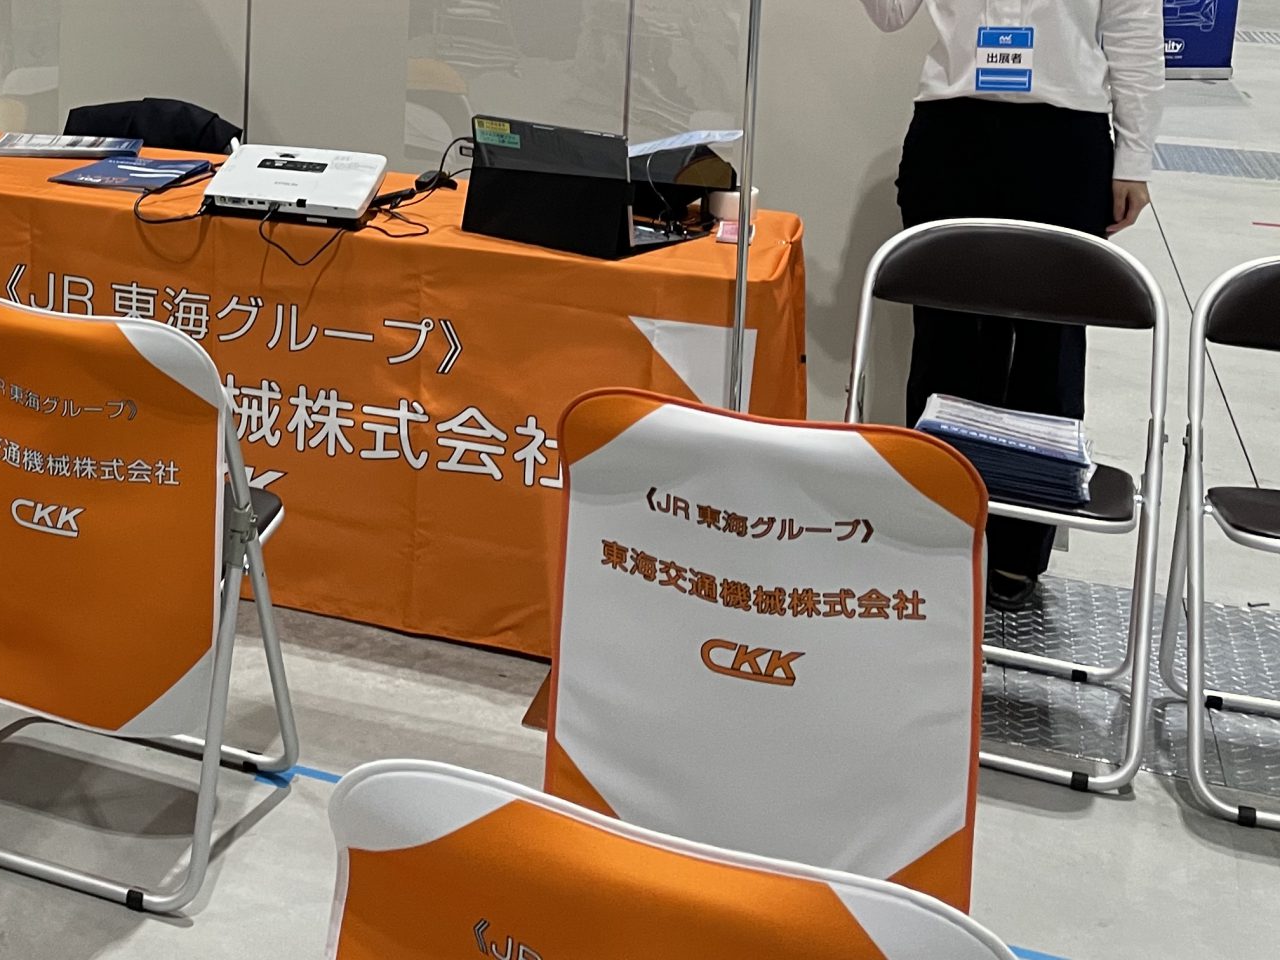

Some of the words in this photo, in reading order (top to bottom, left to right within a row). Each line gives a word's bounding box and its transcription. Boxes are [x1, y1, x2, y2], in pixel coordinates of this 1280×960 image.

[986, 52, 1022, 64] 出展者
[10, 497, 86, 538] CKK
[601, 539, 927, 621] 東海交通機械株式会社
[700, 638, 807, 687] CKK
